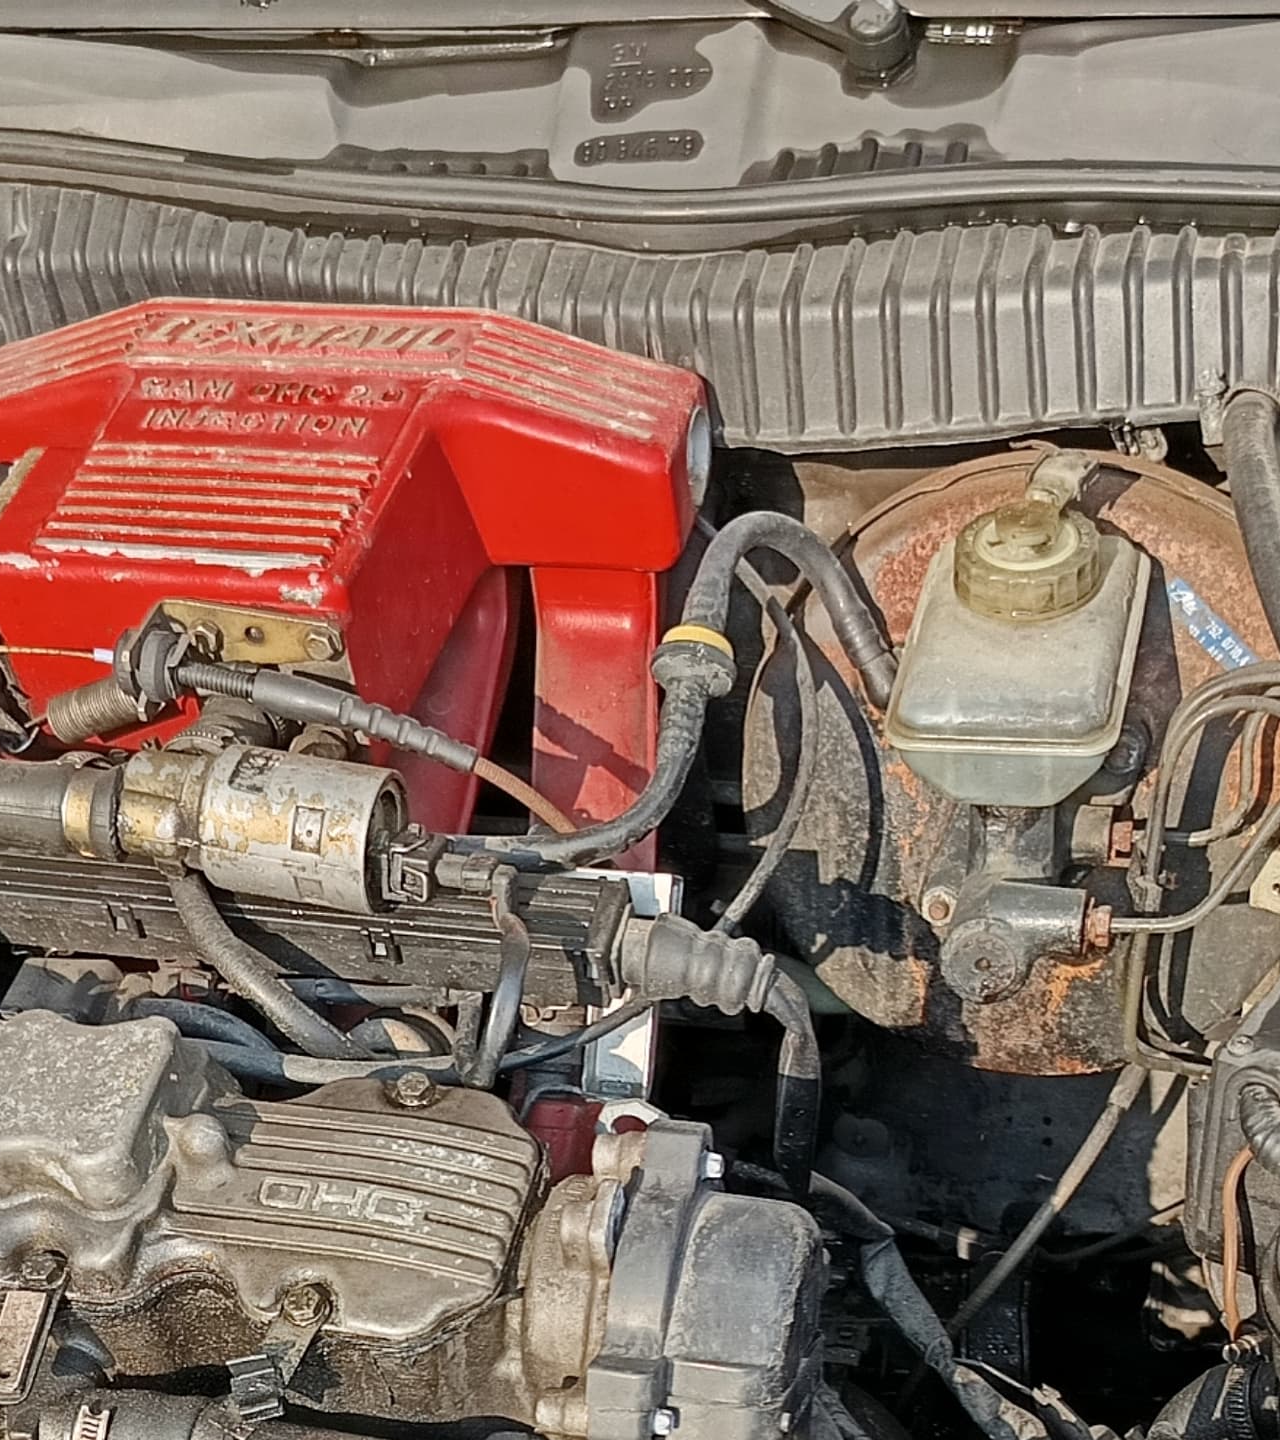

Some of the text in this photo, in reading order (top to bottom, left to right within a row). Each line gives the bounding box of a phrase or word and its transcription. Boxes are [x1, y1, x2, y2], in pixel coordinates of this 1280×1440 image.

[140, 375, 236, 400] RAM
[141, 407, 371, 438] INJECTION
[258, 1175, 424, 1225] OHC
